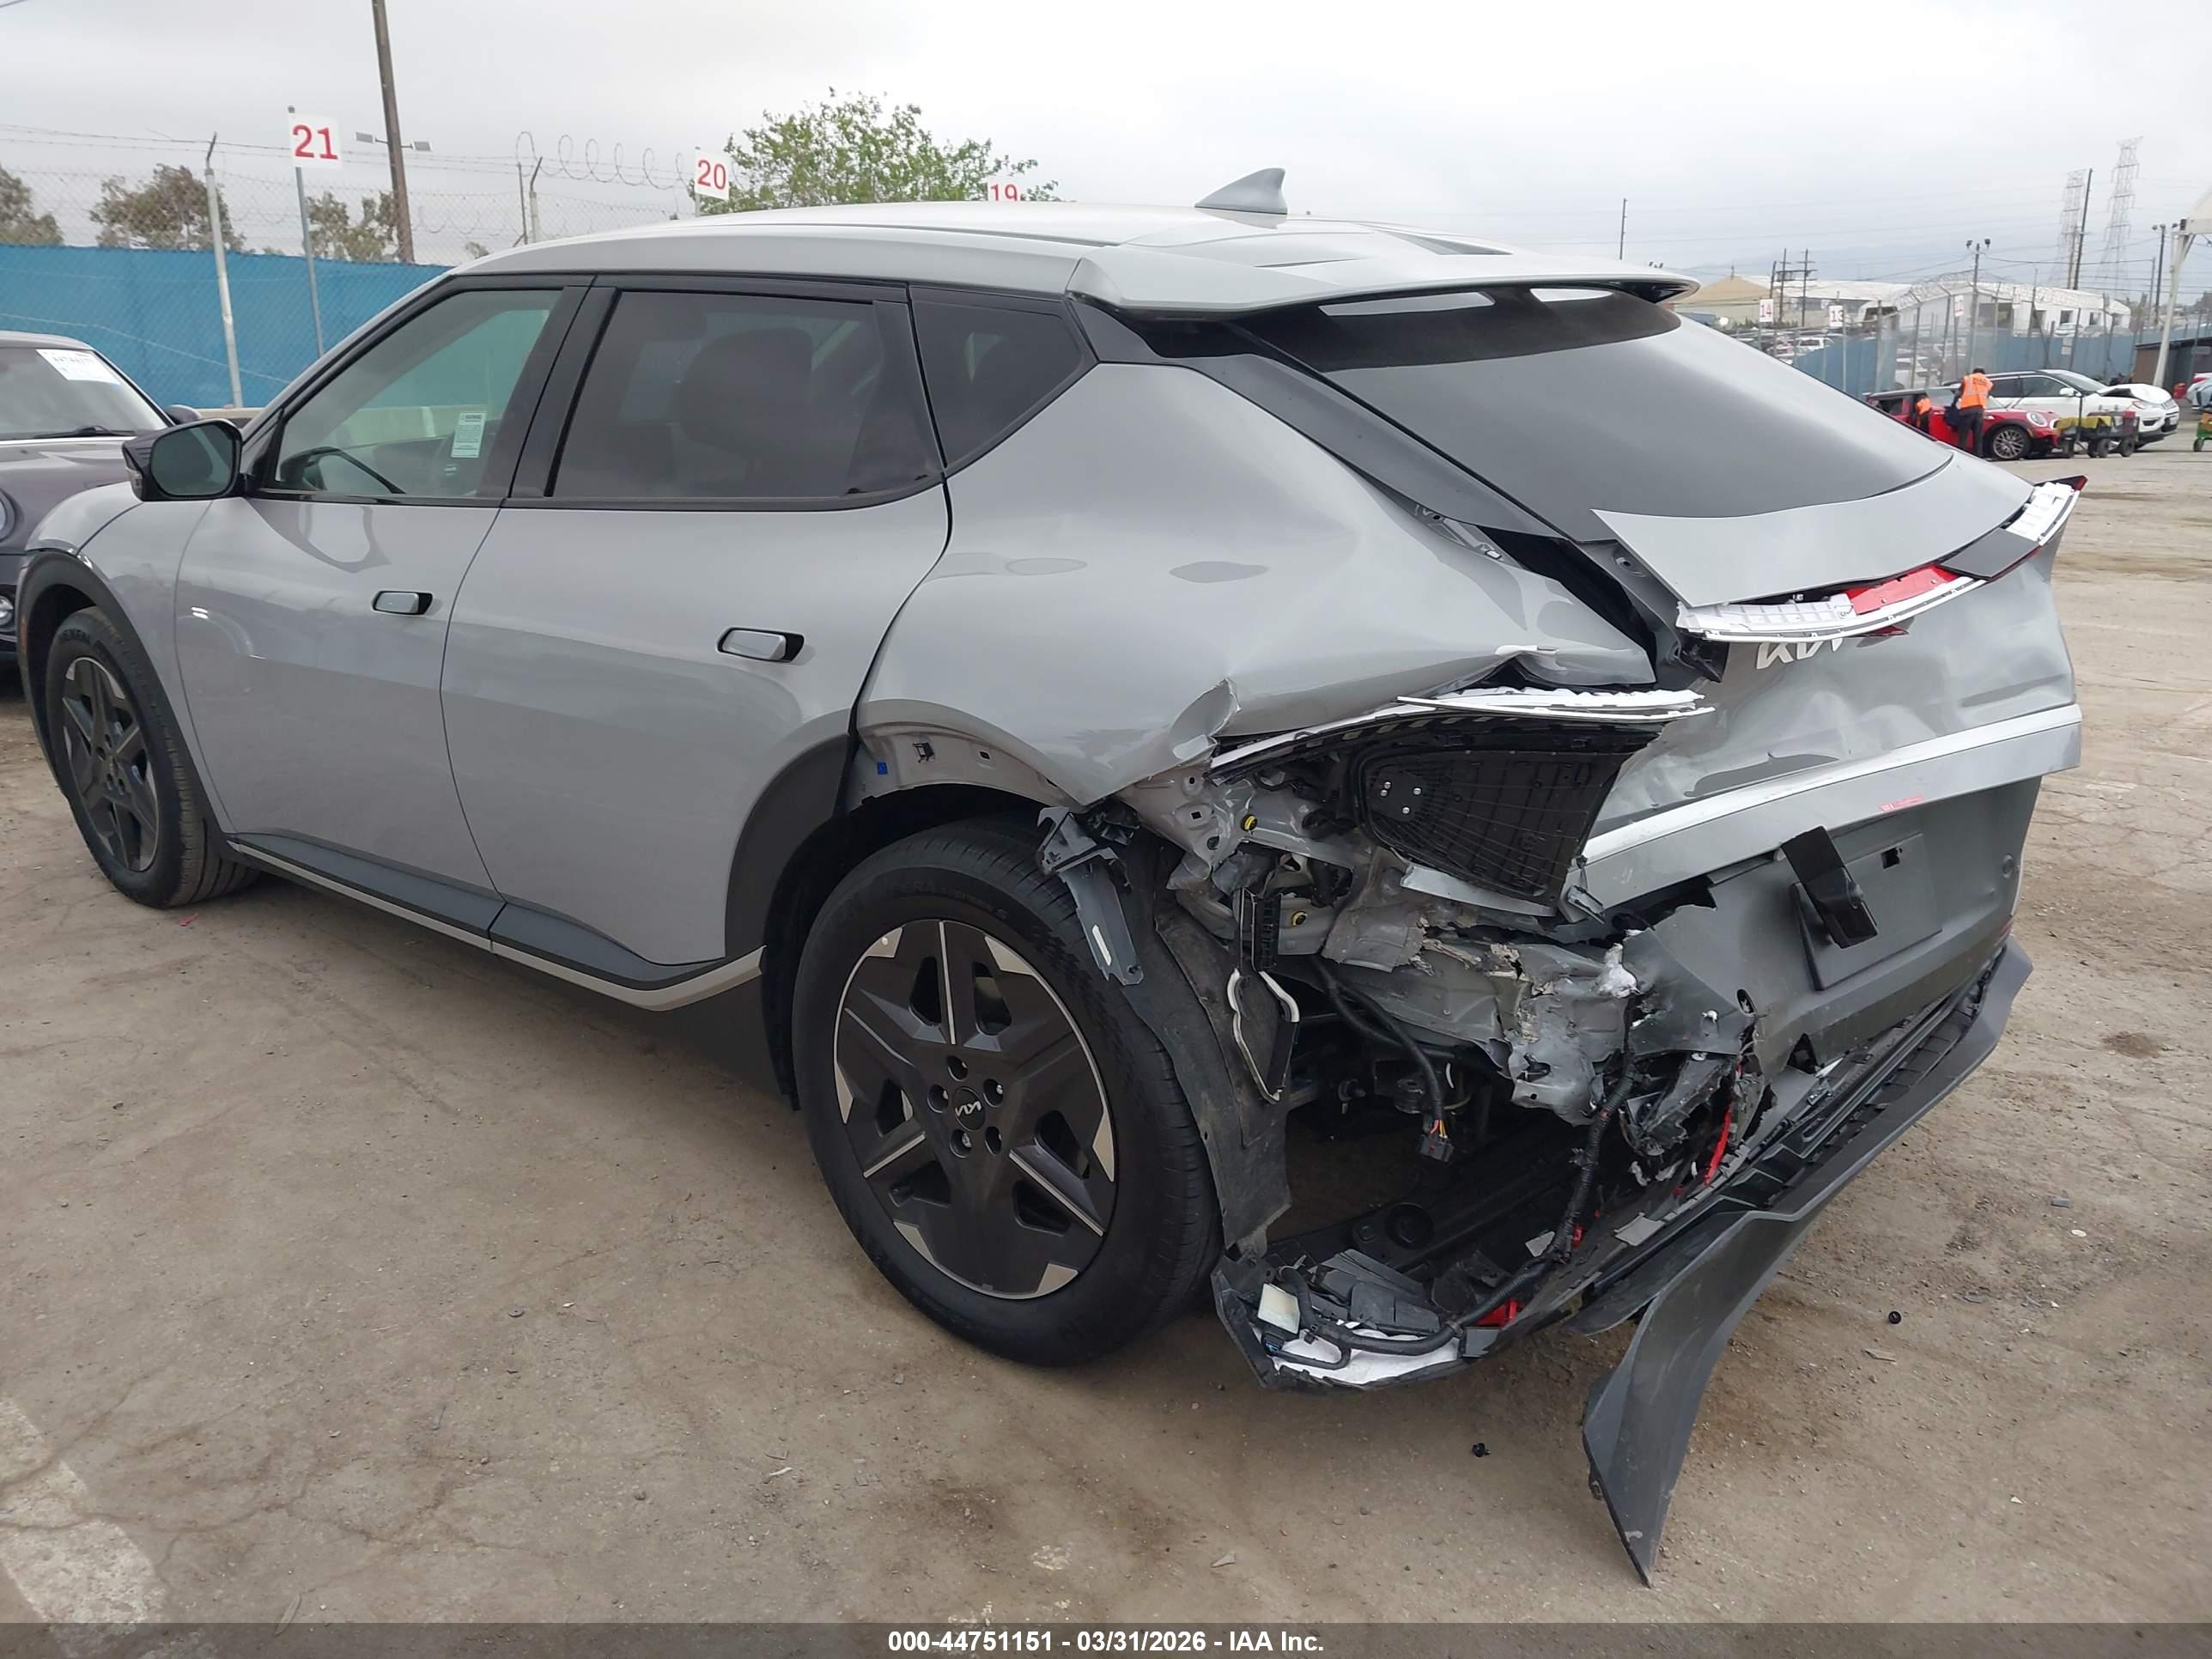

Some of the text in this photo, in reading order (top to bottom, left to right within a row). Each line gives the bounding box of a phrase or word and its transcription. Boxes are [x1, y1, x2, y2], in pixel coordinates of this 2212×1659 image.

[293, 125, 338, 160] 21
[697, 159, 726, 190] 20
[990, 184, 1018, 202] 19
